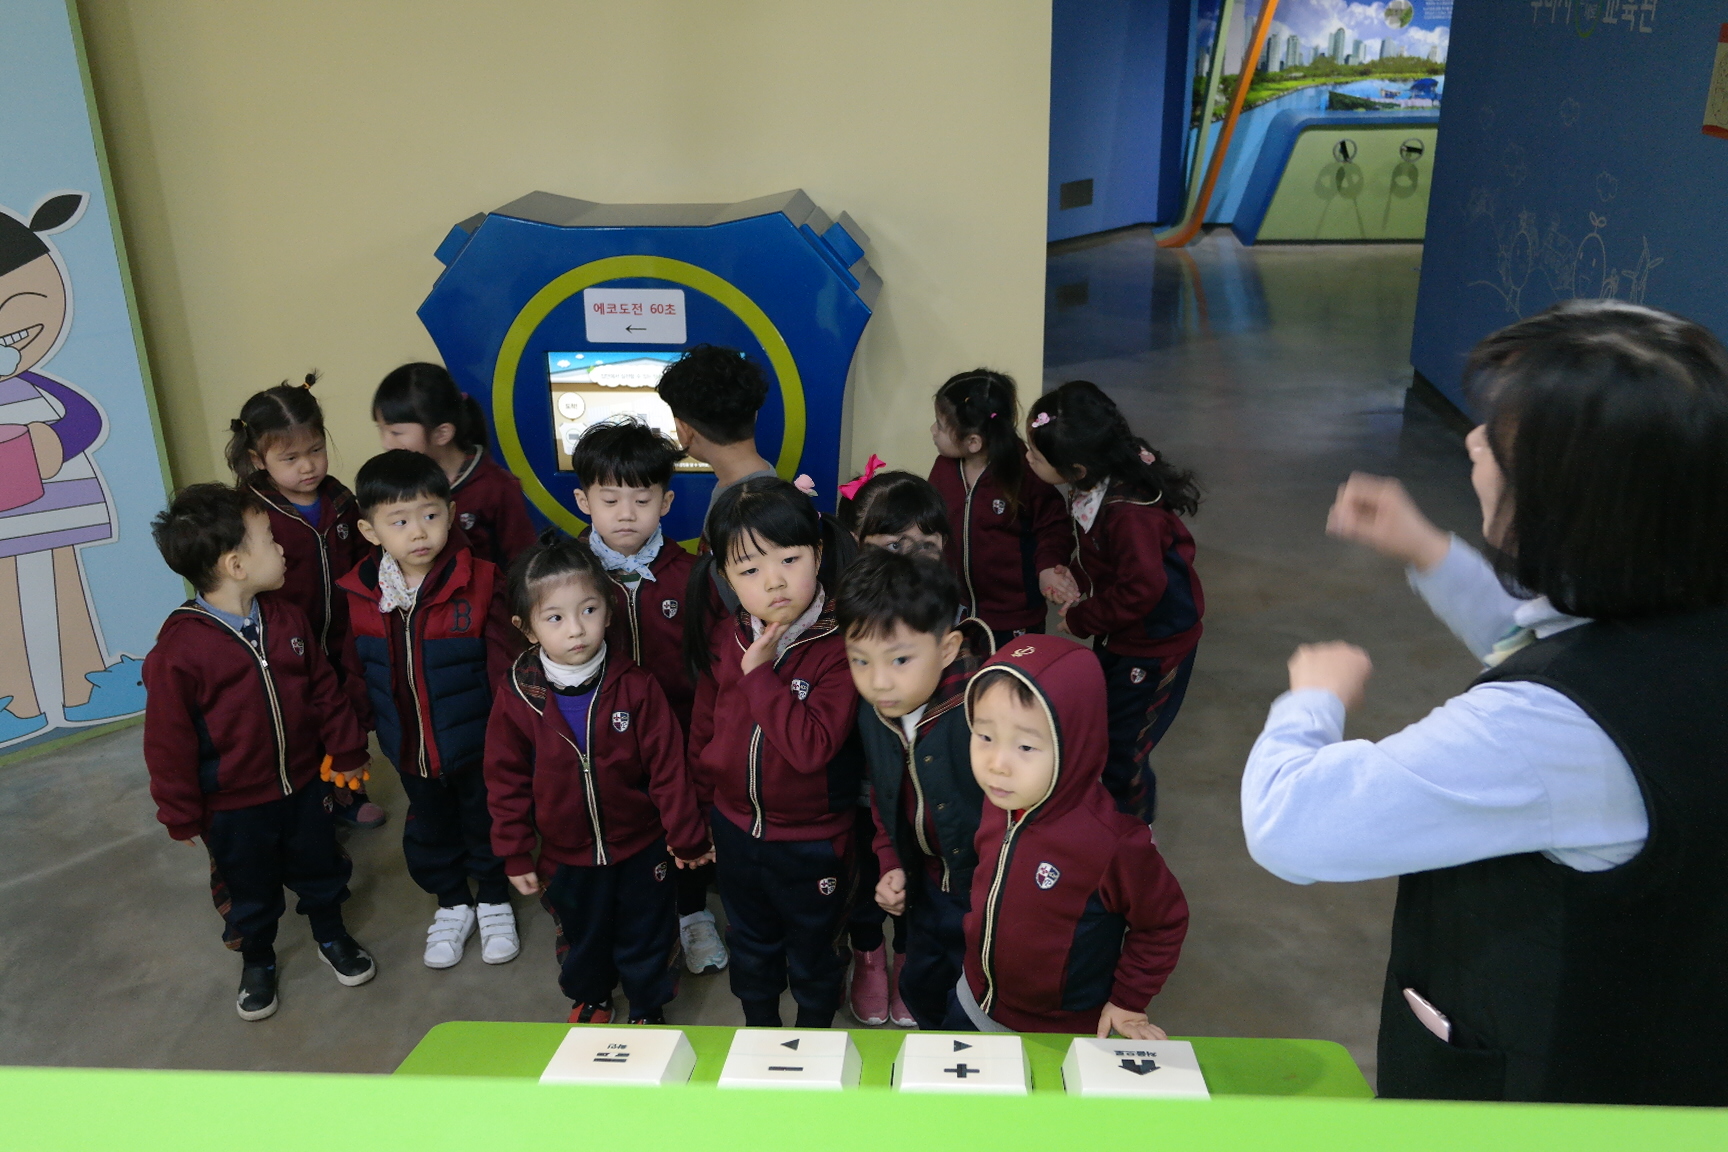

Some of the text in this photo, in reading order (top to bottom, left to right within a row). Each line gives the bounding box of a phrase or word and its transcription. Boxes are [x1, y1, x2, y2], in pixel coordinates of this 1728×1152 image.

[593, 302, 677, 316] 에코도전 60초
[449, 598, 472, 633] B
